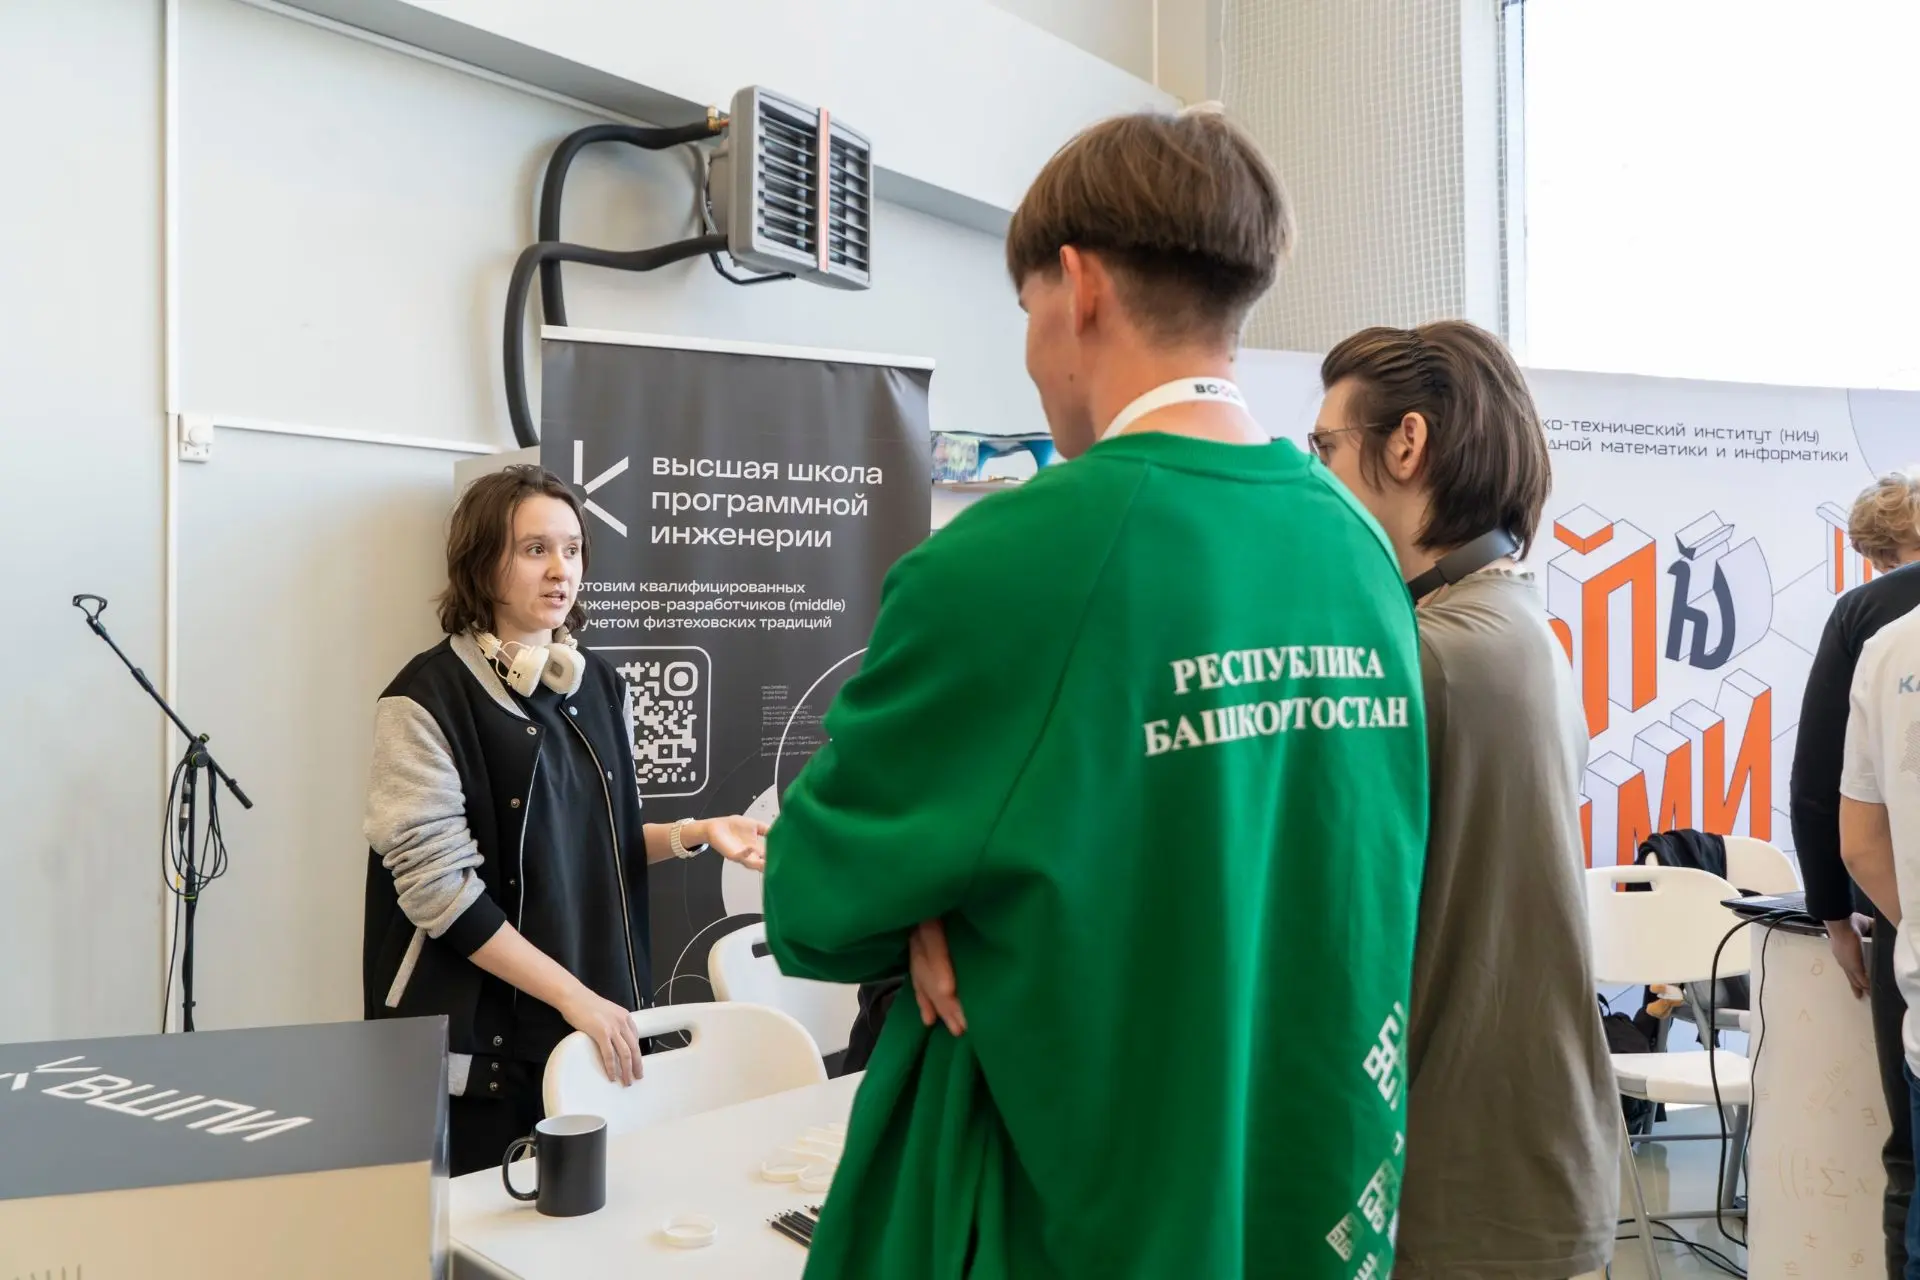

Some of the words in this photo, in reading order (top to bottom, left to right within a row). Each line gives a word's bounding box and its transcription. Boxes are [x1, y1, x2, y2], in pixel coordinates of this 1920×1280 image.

[1542, 419, 1686, 437] ко-технический
[1694, 426, 1772, 445] институт
[1780, 427, 1820, 446] (НИУ)
[1548, 437, 1592, 452] дной
[1601, 441, 1708, 457] математики
[1716, 447, 1726, 459] и
[1734, 447, 1849, 464] информатики
[652, 456, 779, 480] высшая
[788, 462, 883, 485] школа
[651, 491, 868, 518] программной
[651, 525, 832, 552] инженерии
[578, 581, 636, 592] отовим
[639, 580, 806, 596] квалифицированных
[579, 598, 786, 613] нженеров-разработчиков
[789, 598, 846, 612] (middle)
[580, 617, 640, 632] учетом
[643, 615, 756, 631] физтеховских
[759, 616, 832, 631] традиций
[1170, 645, 1385, 695] РЕСПУБЛИКА
[1143, 696, 1409, 757] БАШКОРТОСТАН
[41, 1074, 313, 1142] ВШПИ
